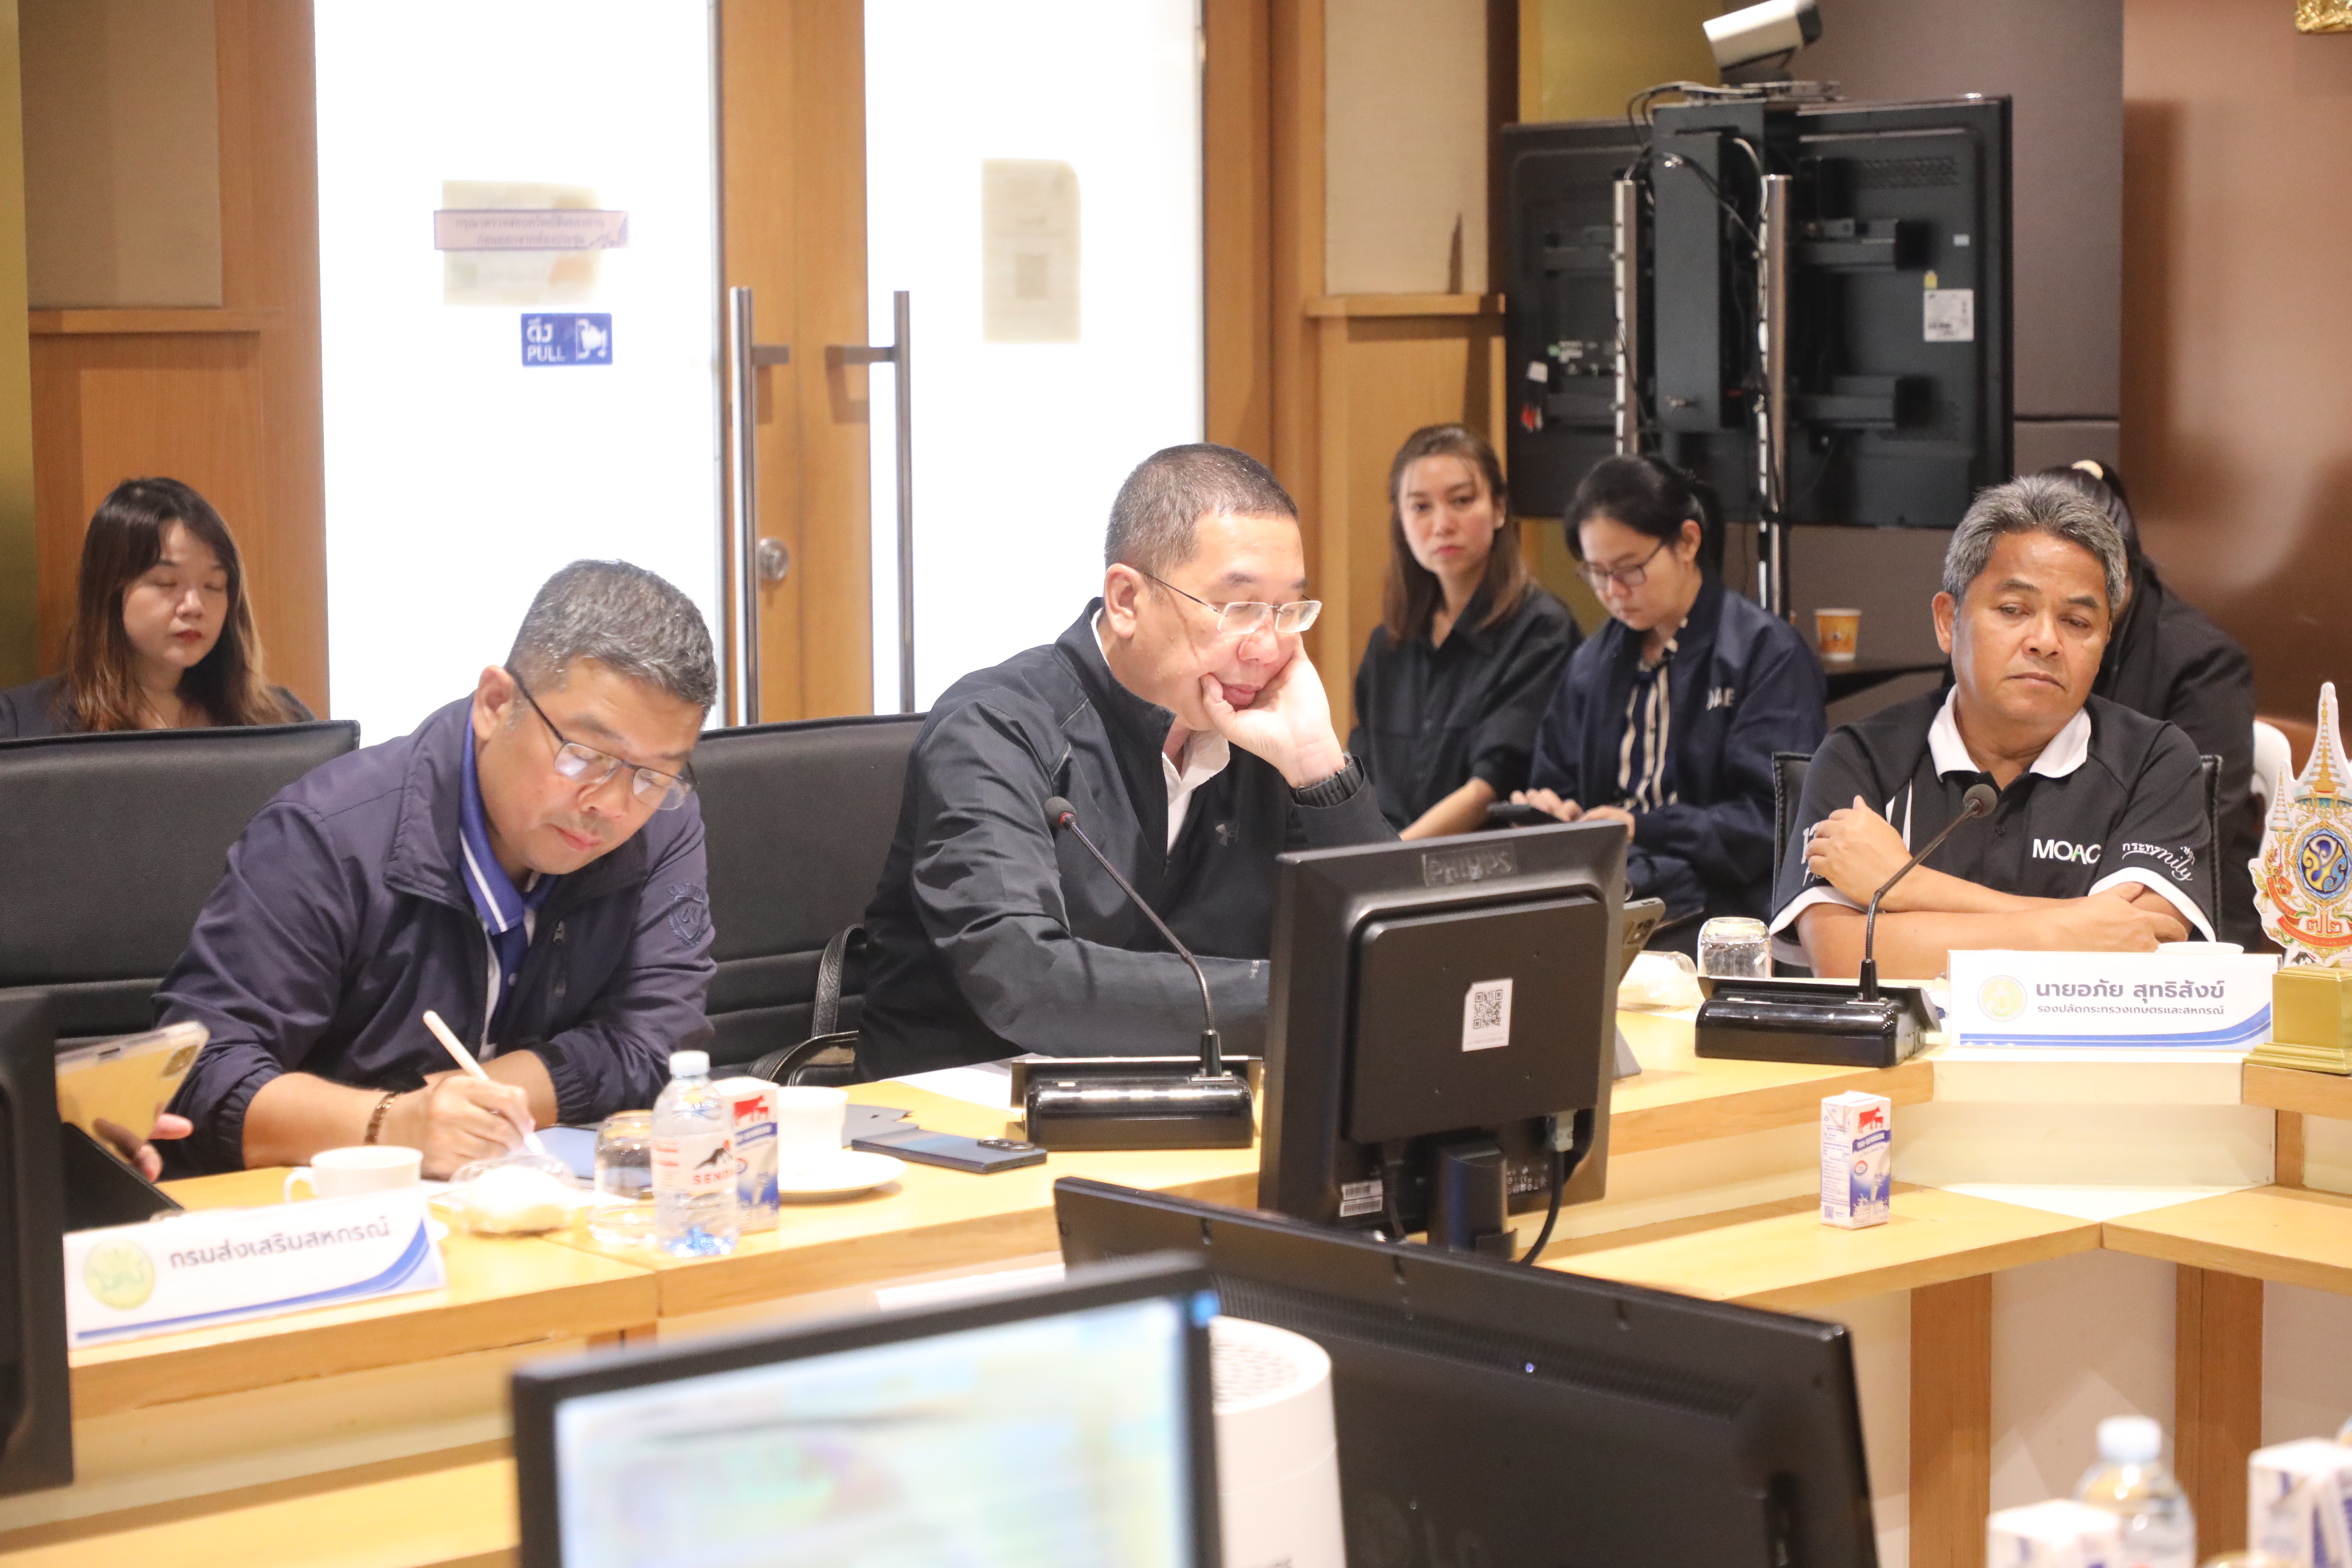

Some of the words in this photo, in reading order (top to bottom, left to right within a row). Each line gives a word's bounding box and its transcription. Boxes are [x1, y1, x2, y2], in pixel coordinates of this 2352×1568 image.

[527, 317, 554, 344] ดึง
[527, 345, 566, 362] PULL
[2032, 838, 2101, 865] MOAC
[2036, 978, 2124, 997] นายอภัย
[2133, 979, 2225, 1004] สุทธิสังข์
[2037, 1003, 2224, 1015] รองปลัดกระทรวงเกษตรและสหกรณ์
[169, 1216, 390, 1269] กรมส่งเสริมสหกรณ์
